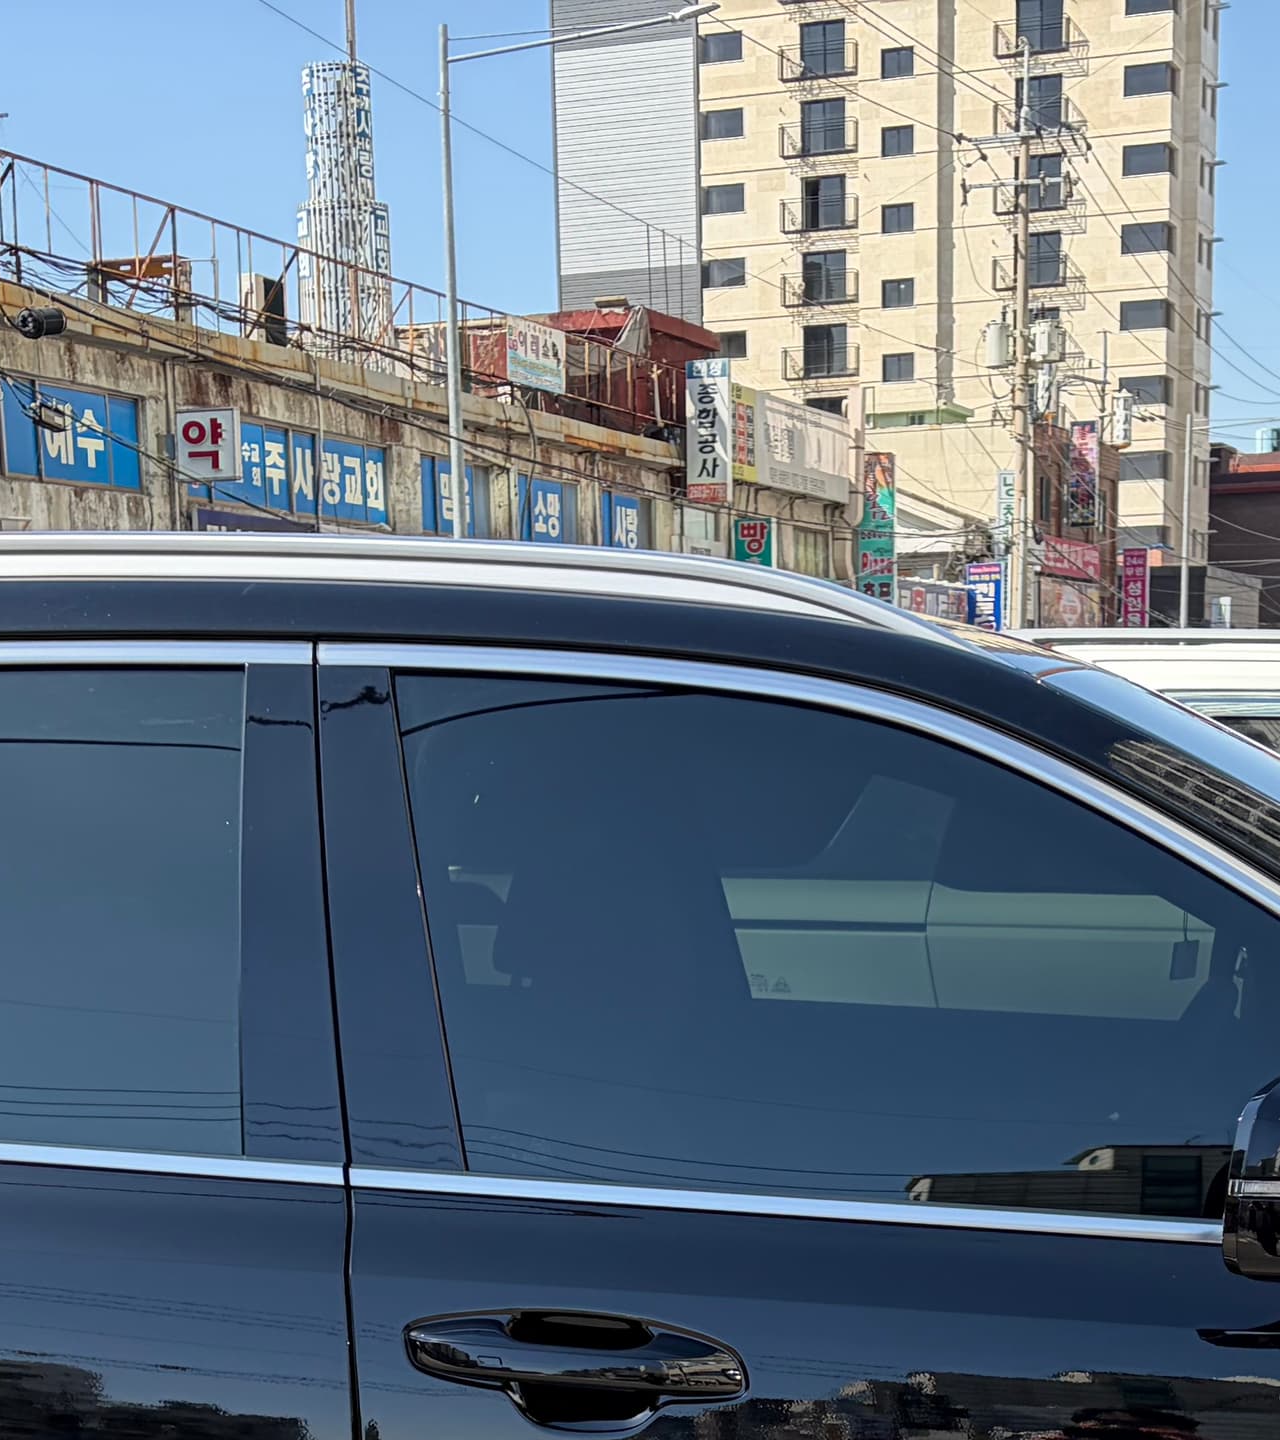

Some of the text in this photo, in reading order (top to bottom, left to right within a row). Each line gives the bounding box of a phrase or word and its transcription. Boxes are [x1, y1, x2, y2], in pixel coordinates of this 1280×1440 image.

[182, 418, 223, 471] 약
[697, 383, 719, 478] 종합공사
[266, 440, 385, 511] 주사랑교회
[534, 491, 560, 538] 소망
[615, 506, 637, 549] 사랑
[739, 522, 768, 554] 빵
